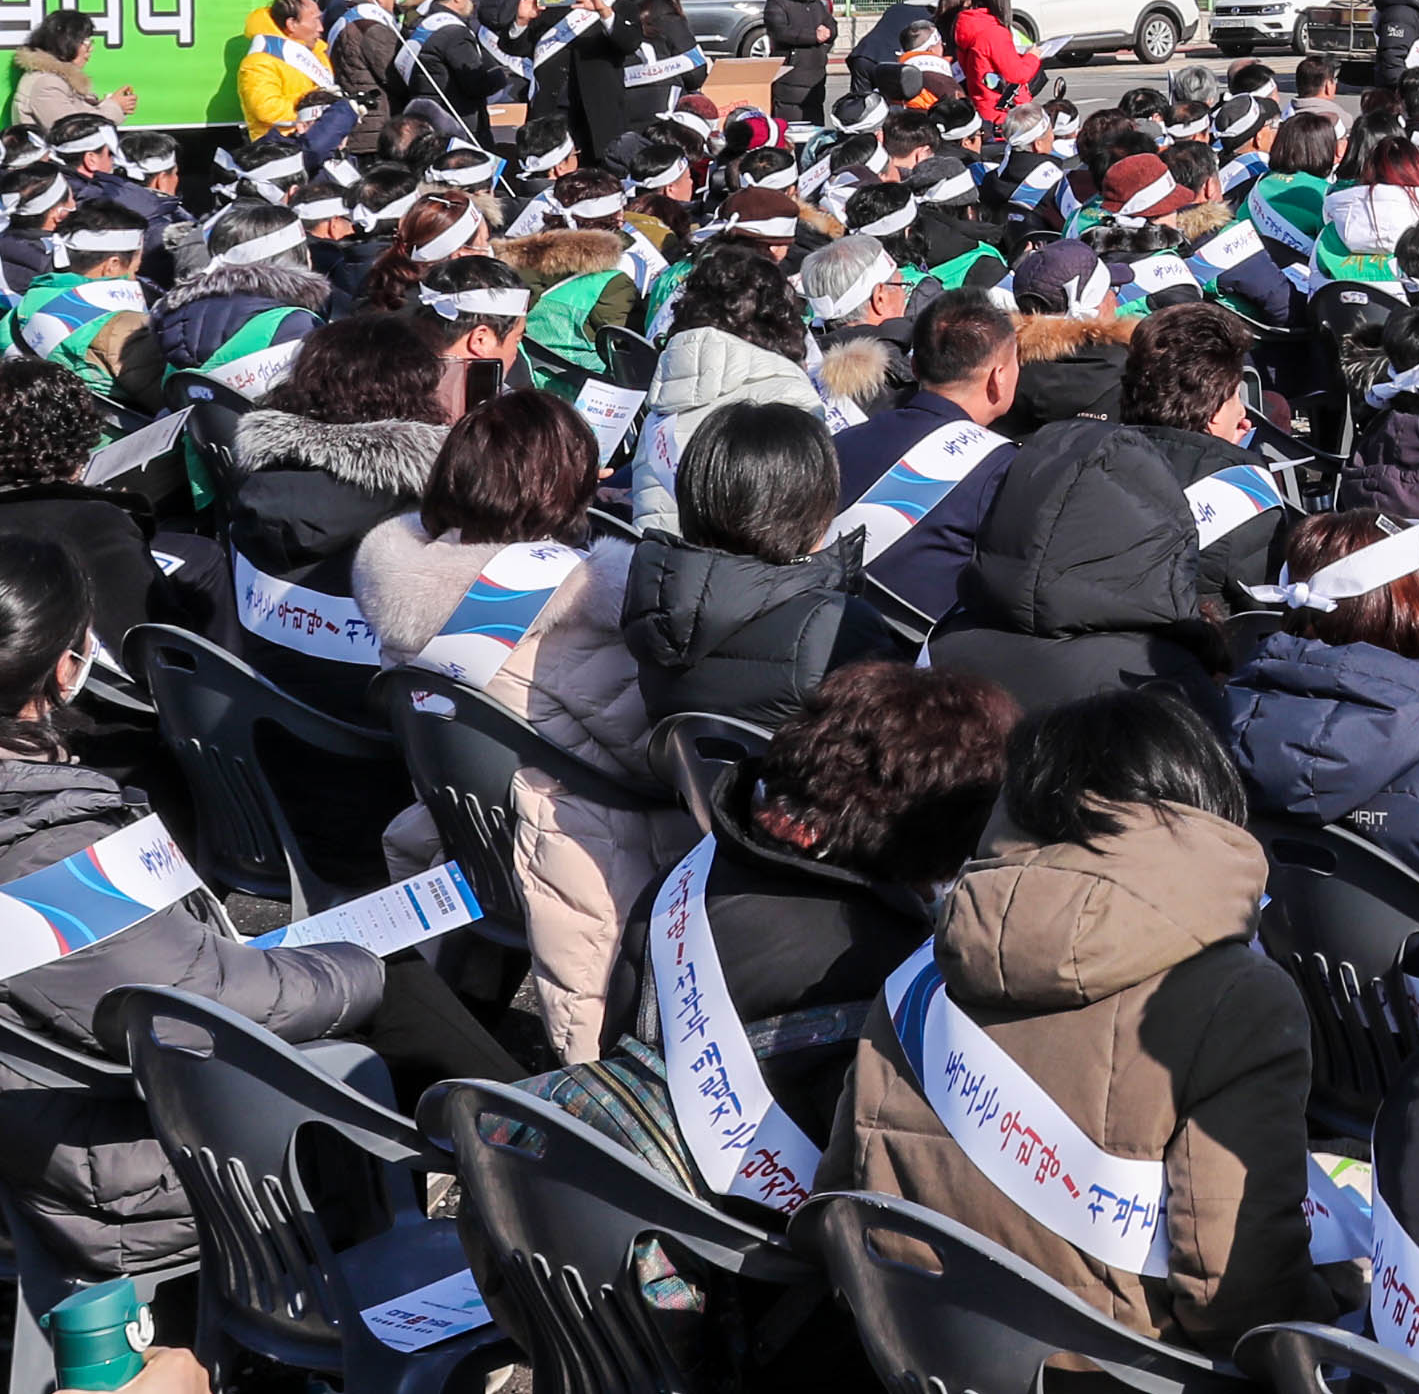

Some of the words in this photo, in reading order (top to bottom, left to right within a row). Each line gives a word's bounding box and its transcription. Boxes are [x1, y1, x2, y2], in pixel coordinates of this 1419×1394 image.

[667, 869, 696, 966] 우리땅!
[673, 961, 712, 1044] 서부두
[689, 1040, 758, 1151] 매립지는
[944, 1050, 1001, 1129] 독도는
[999, 1110, 1082, 1200] 우리땅!
